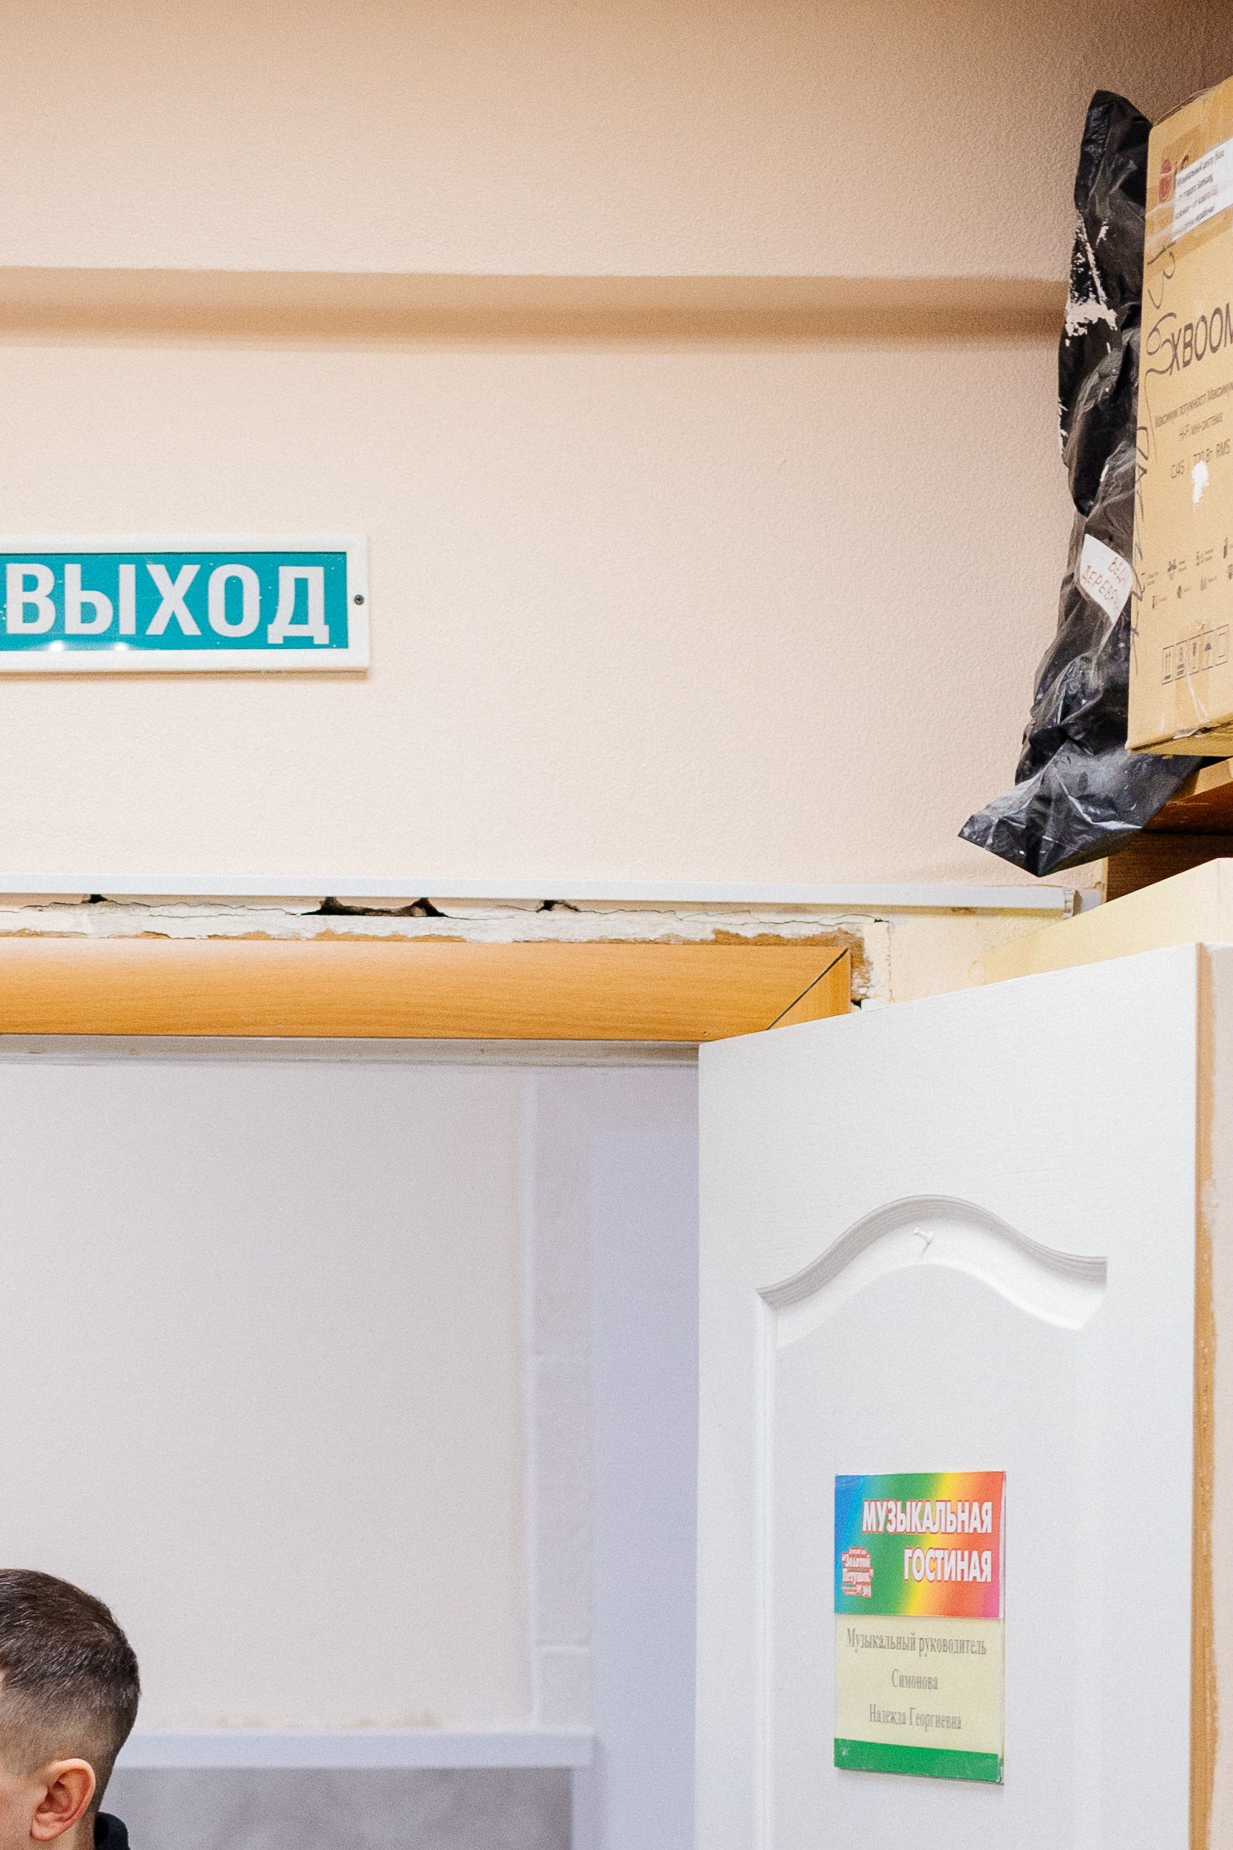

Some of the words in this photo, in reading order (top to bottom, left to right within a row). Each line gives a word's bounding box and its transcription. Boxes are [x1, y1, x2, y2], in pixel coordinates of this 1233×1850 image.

[5, 563, 330, 645] ВЫХОД
[862, 1500, 993, 1534] МУЗЫКАЛЬНАЯ
[904, 1548, 992, 1583] ГОСТИНАЯ
[846, 1628, 916, 1654] Музыкальный
[918, 1636, 987, 1657] руководитель
[891, 1669, 938, 1690] Симонова
[869, 1704, 906, 1725] Надежда
[909, 1707, 962, 1733] Георгиевна
